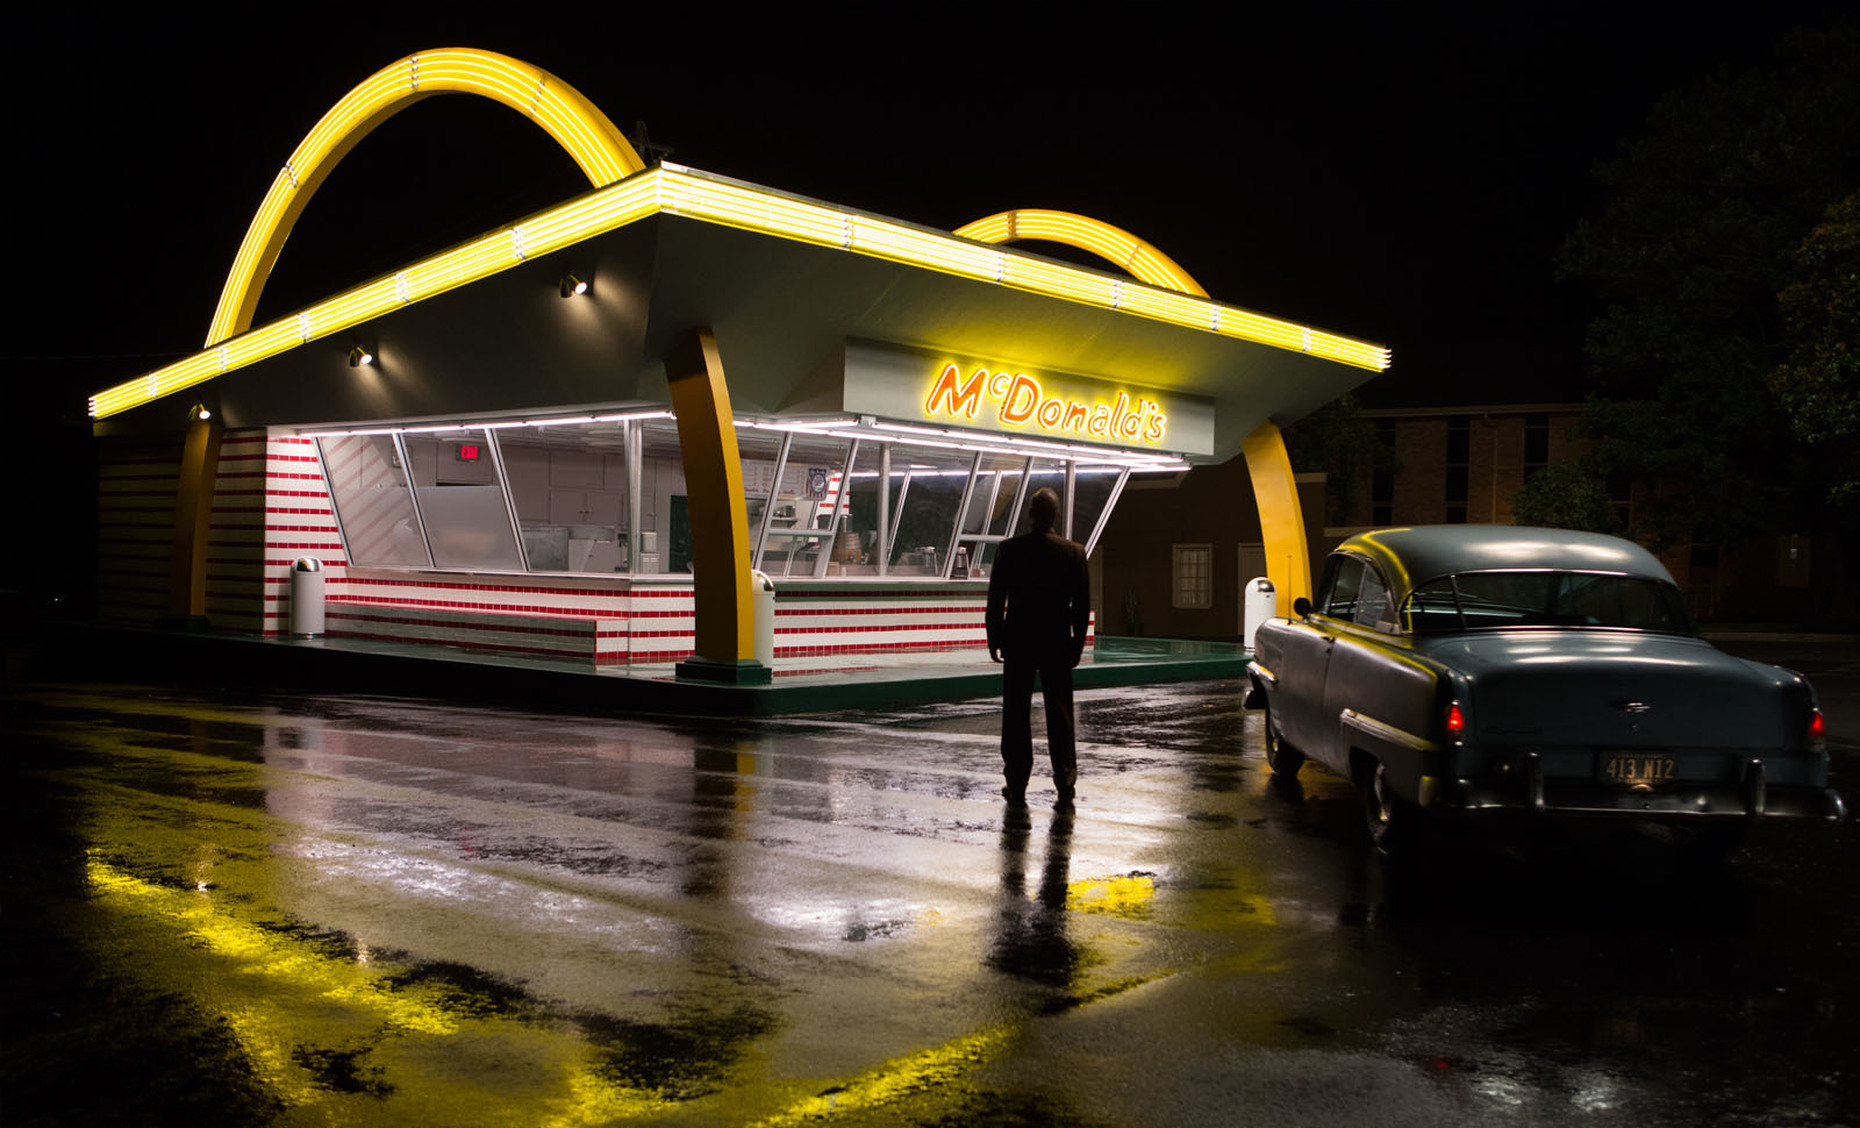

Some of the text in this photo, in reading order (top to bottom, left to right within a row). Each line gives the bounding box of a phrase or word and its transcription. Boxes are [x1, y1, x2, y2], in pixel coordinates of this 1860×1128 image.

[926, 363, 1168, 441] McDonald's
[1606, 758, 1675, 779] 413 N12
